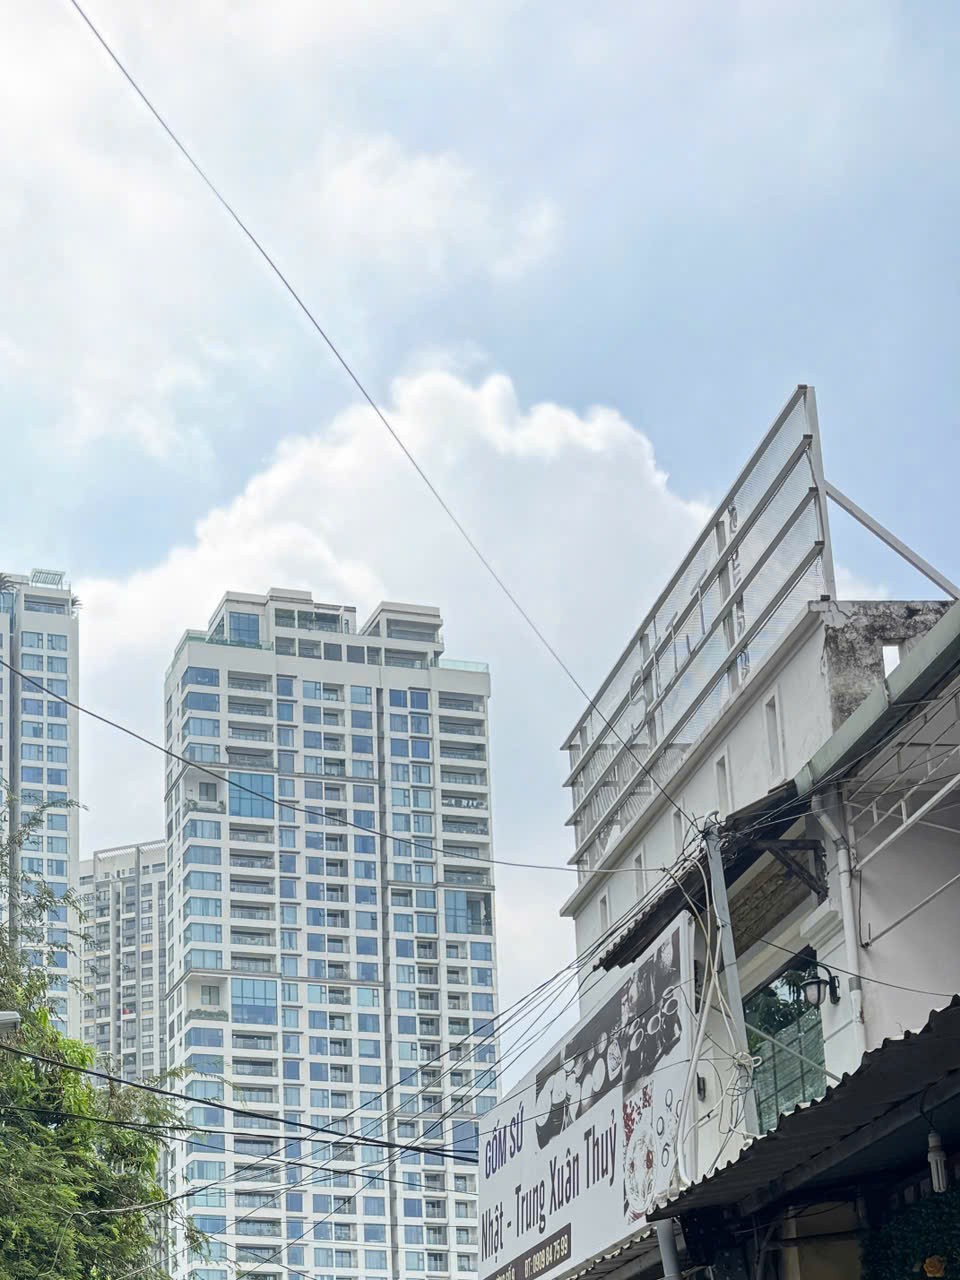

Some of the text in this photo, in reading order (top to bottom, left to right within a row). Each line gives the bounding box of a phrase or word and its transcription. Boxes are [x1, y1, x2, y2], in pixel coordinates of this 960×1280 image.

[485, 1101, 525, 1180] GỐM SỨ
[481, 1201, 504, 1264] Nhật
[515, 1184, 547, 1235] Trung
[549, 1147, 580, 1216] Xuân
